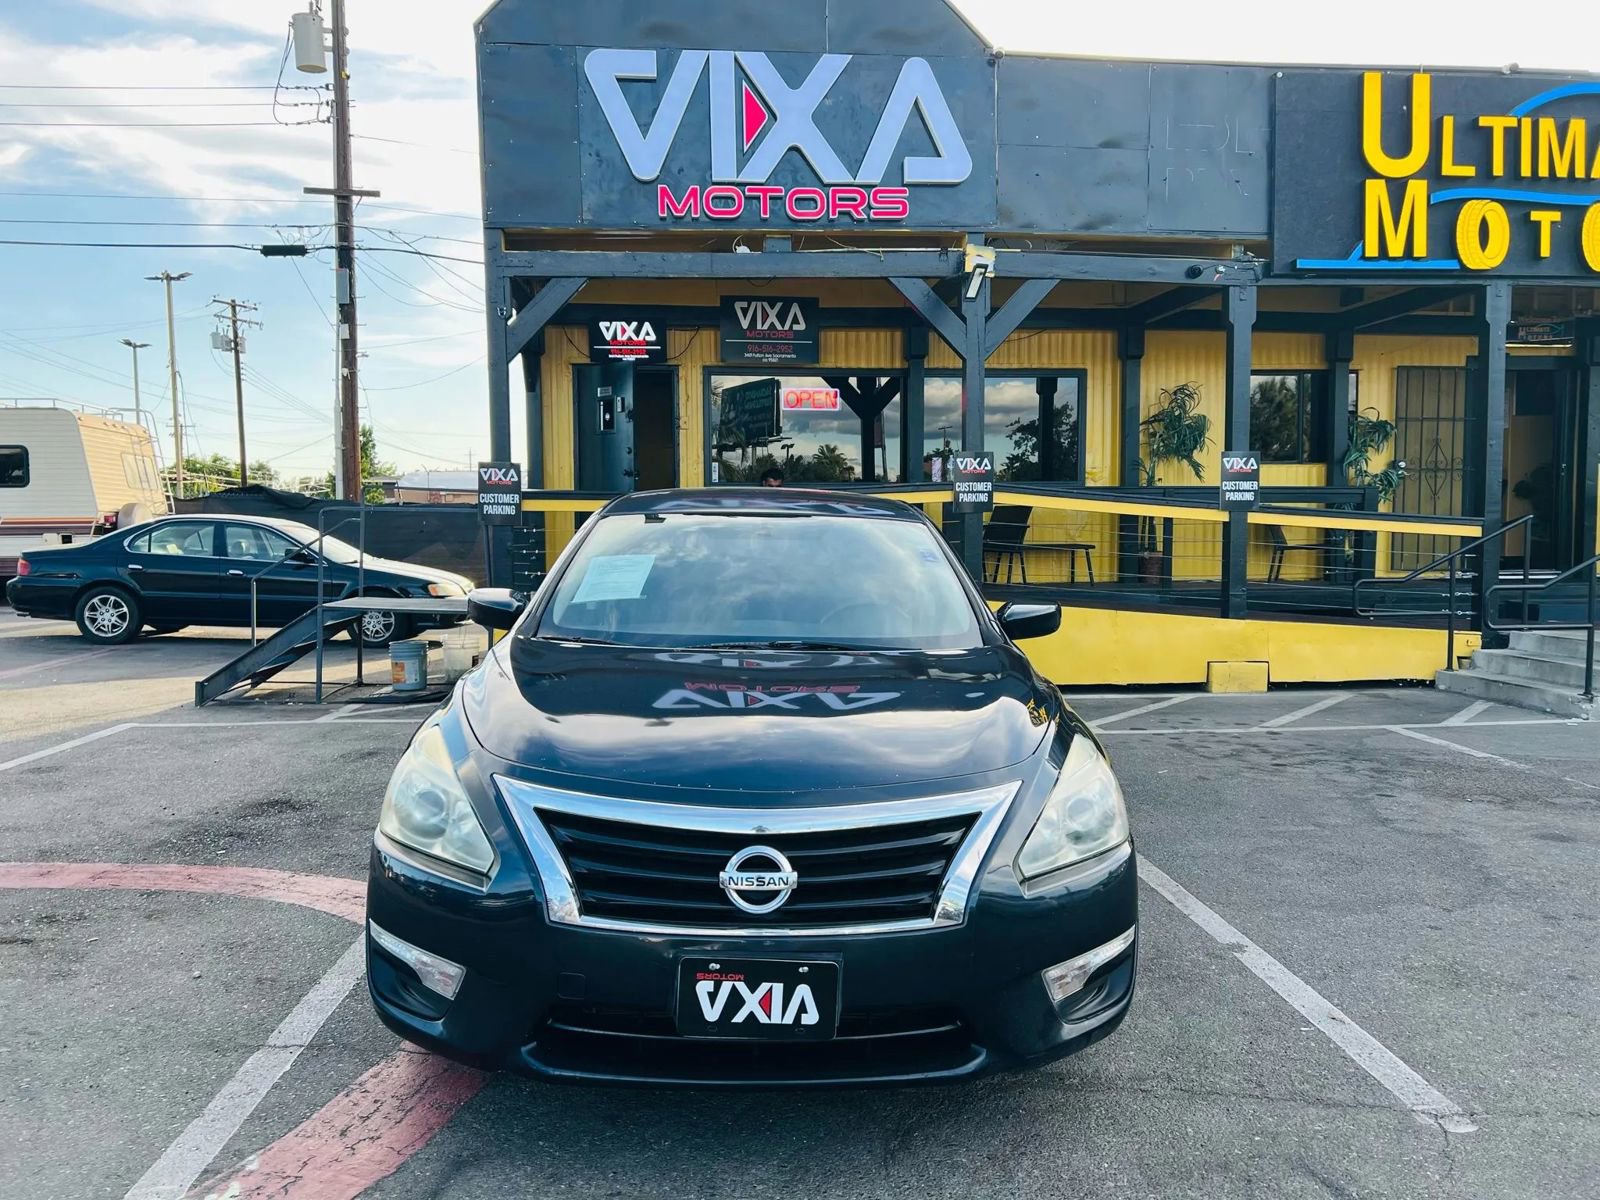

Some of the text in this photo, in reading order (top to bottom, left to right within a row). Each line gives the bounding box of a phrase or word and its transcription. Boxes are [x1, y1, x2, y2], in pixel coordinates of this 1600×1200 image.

[584, 48, 973, 185] VIXA
[1363, 72, 1600, 178] ULTIM
[657, 184, 910, 220] MOTORS
[734, 301, 806, 330] VIXA
[598, 321, 656, 341] VIXA
[746, 330, 794, 338] MOTORS
[784, 390, 838, 409] OPEN
[956, 457, 991, 470] VIXA
[1223, 457, 1258, 469] VIXA
[480, 467, 518, 481] VIXA
[956, 482, 992, 491] CUSTOMER
[1222, 481, 1258, 490] CUSTOMER
[480, 493, 519, 503] CUSTOMER
[959, 492, 988, 503] PARKING
[1225, 491, 1255, 501] PARKING
[483, 505, 516, 515] PARKING
[728, 876, 789, 887] NISSAN
